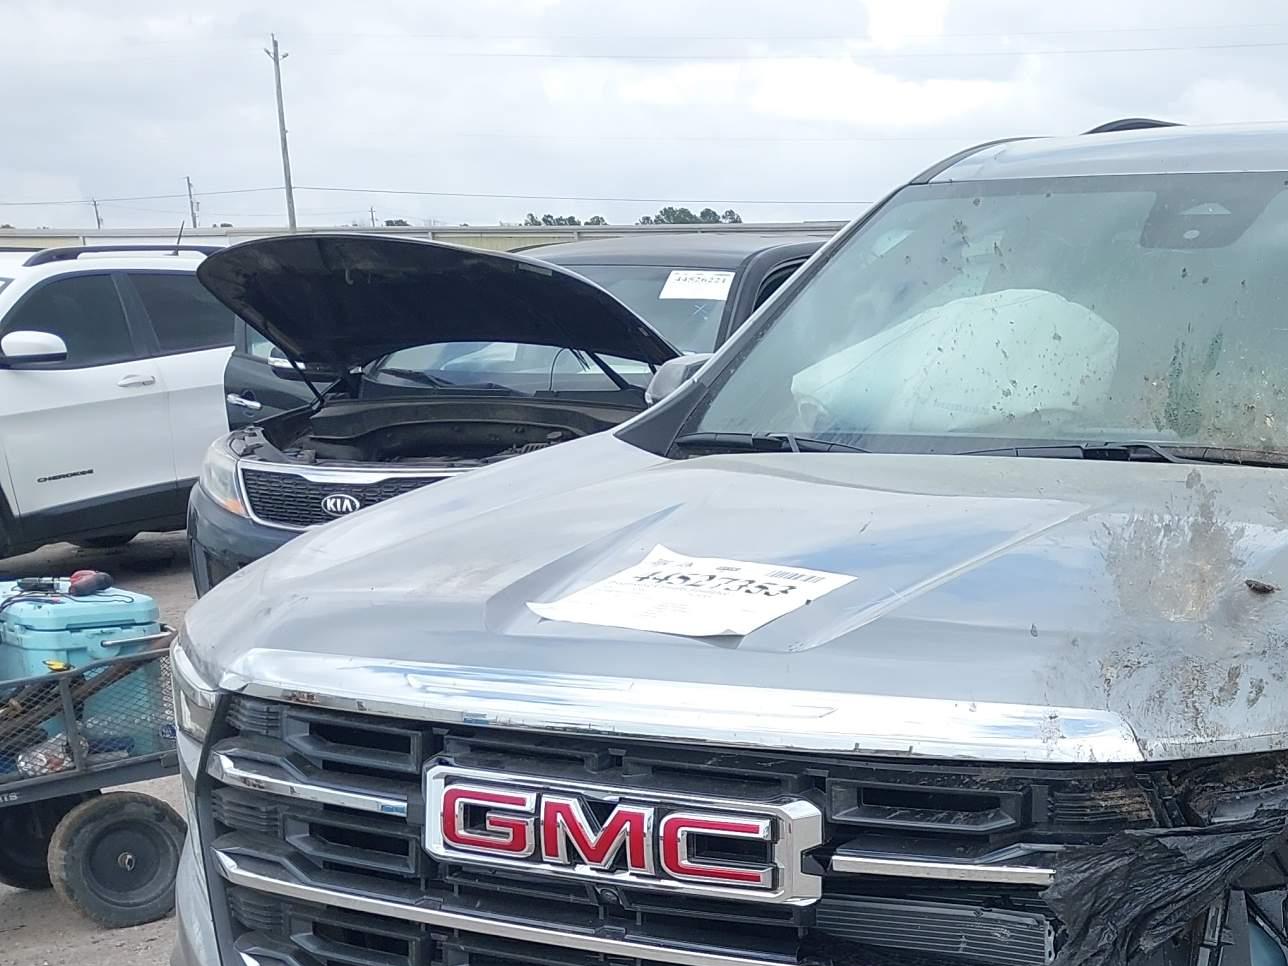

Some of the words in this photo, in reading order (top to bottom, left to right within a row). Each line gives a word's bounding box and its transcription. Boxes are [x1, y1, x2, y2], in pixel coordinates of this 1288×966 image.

[326, 498, 353, 512] KIA
[634, 570, 797, 597] 44527353
[442, 784, 774, 889] GMC
